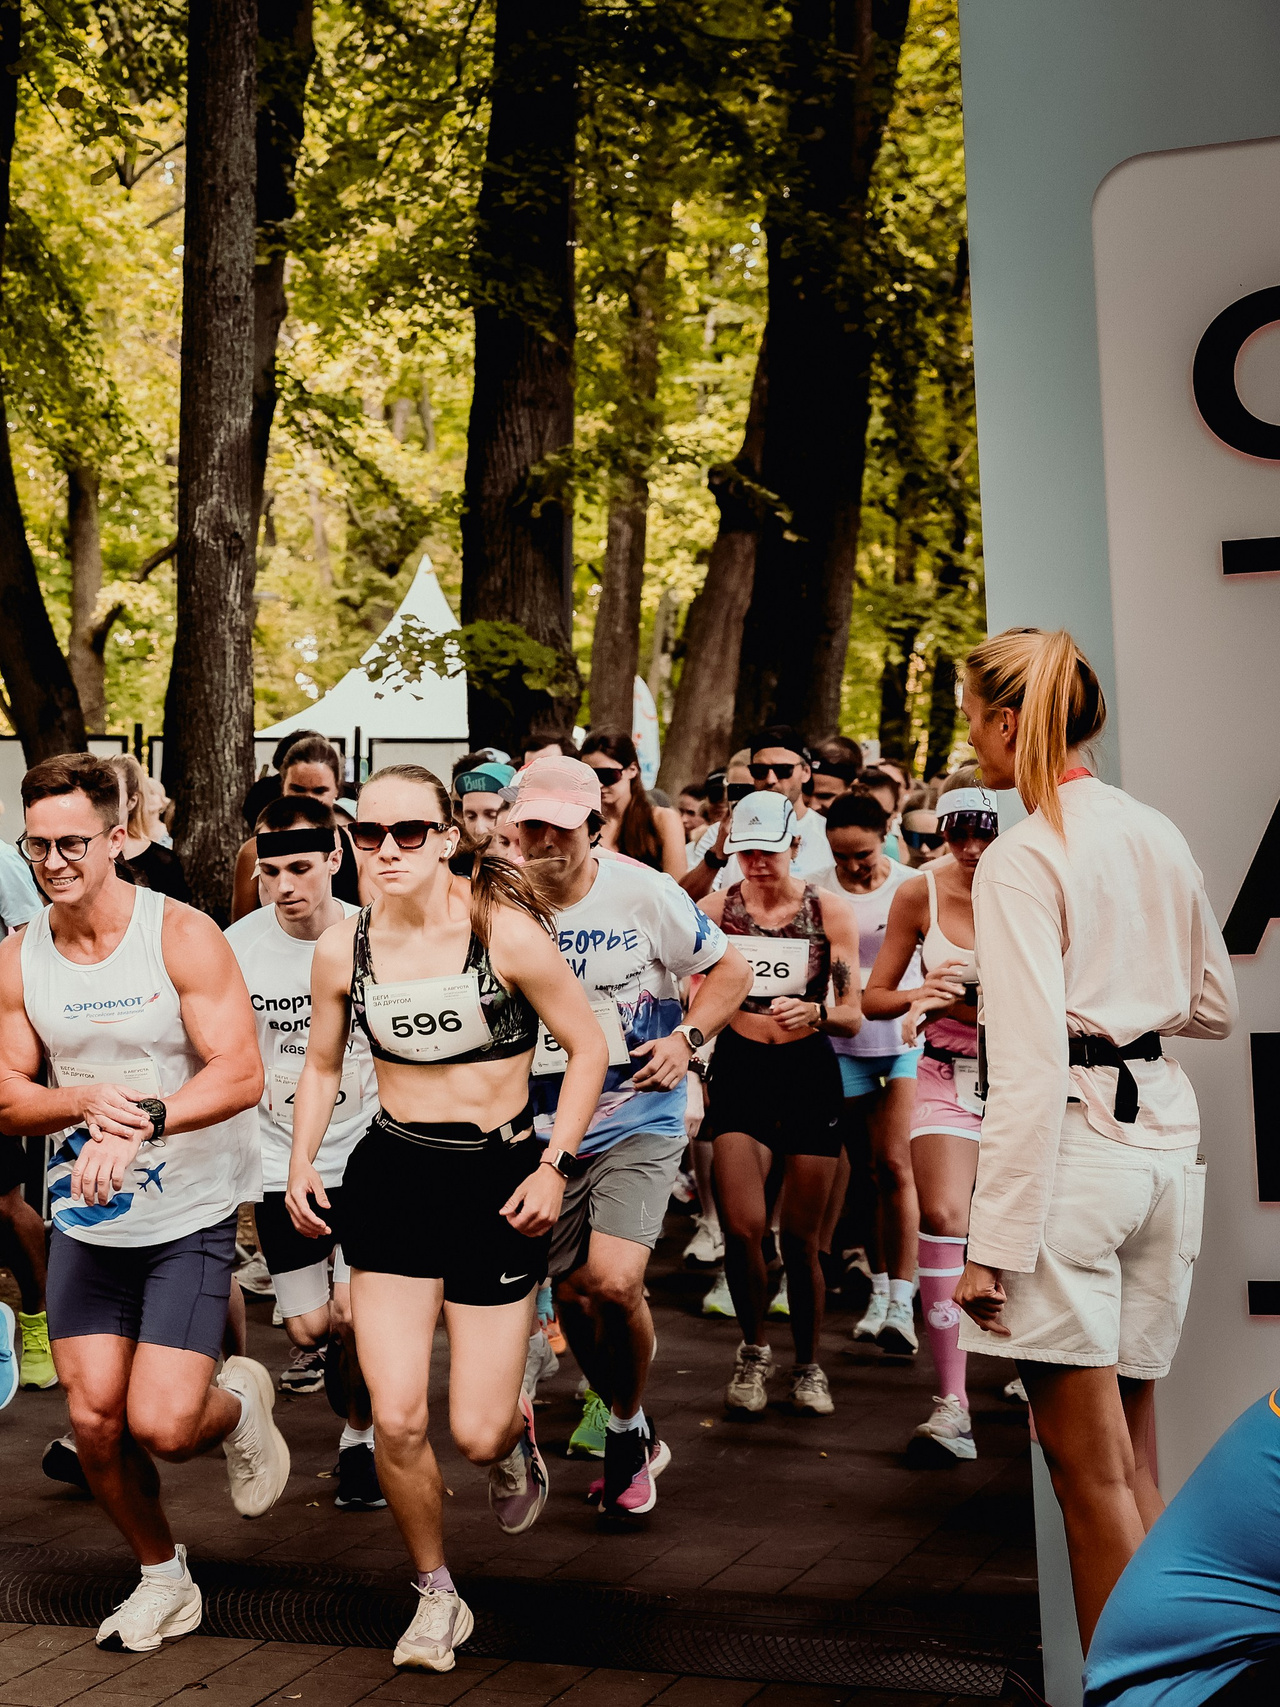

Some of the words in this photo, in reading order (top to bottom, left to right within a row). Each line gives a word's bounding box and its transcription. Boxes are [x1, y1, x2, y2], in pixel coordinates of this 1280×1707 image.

[557, 929, 639, 954] БОРЬЕ
[63, 996, 143, 1013] АЭРОФЛОТ
[382, 997, 412, 1007] ДРУГОМ
[391, 1010, 463, 1038] 596
